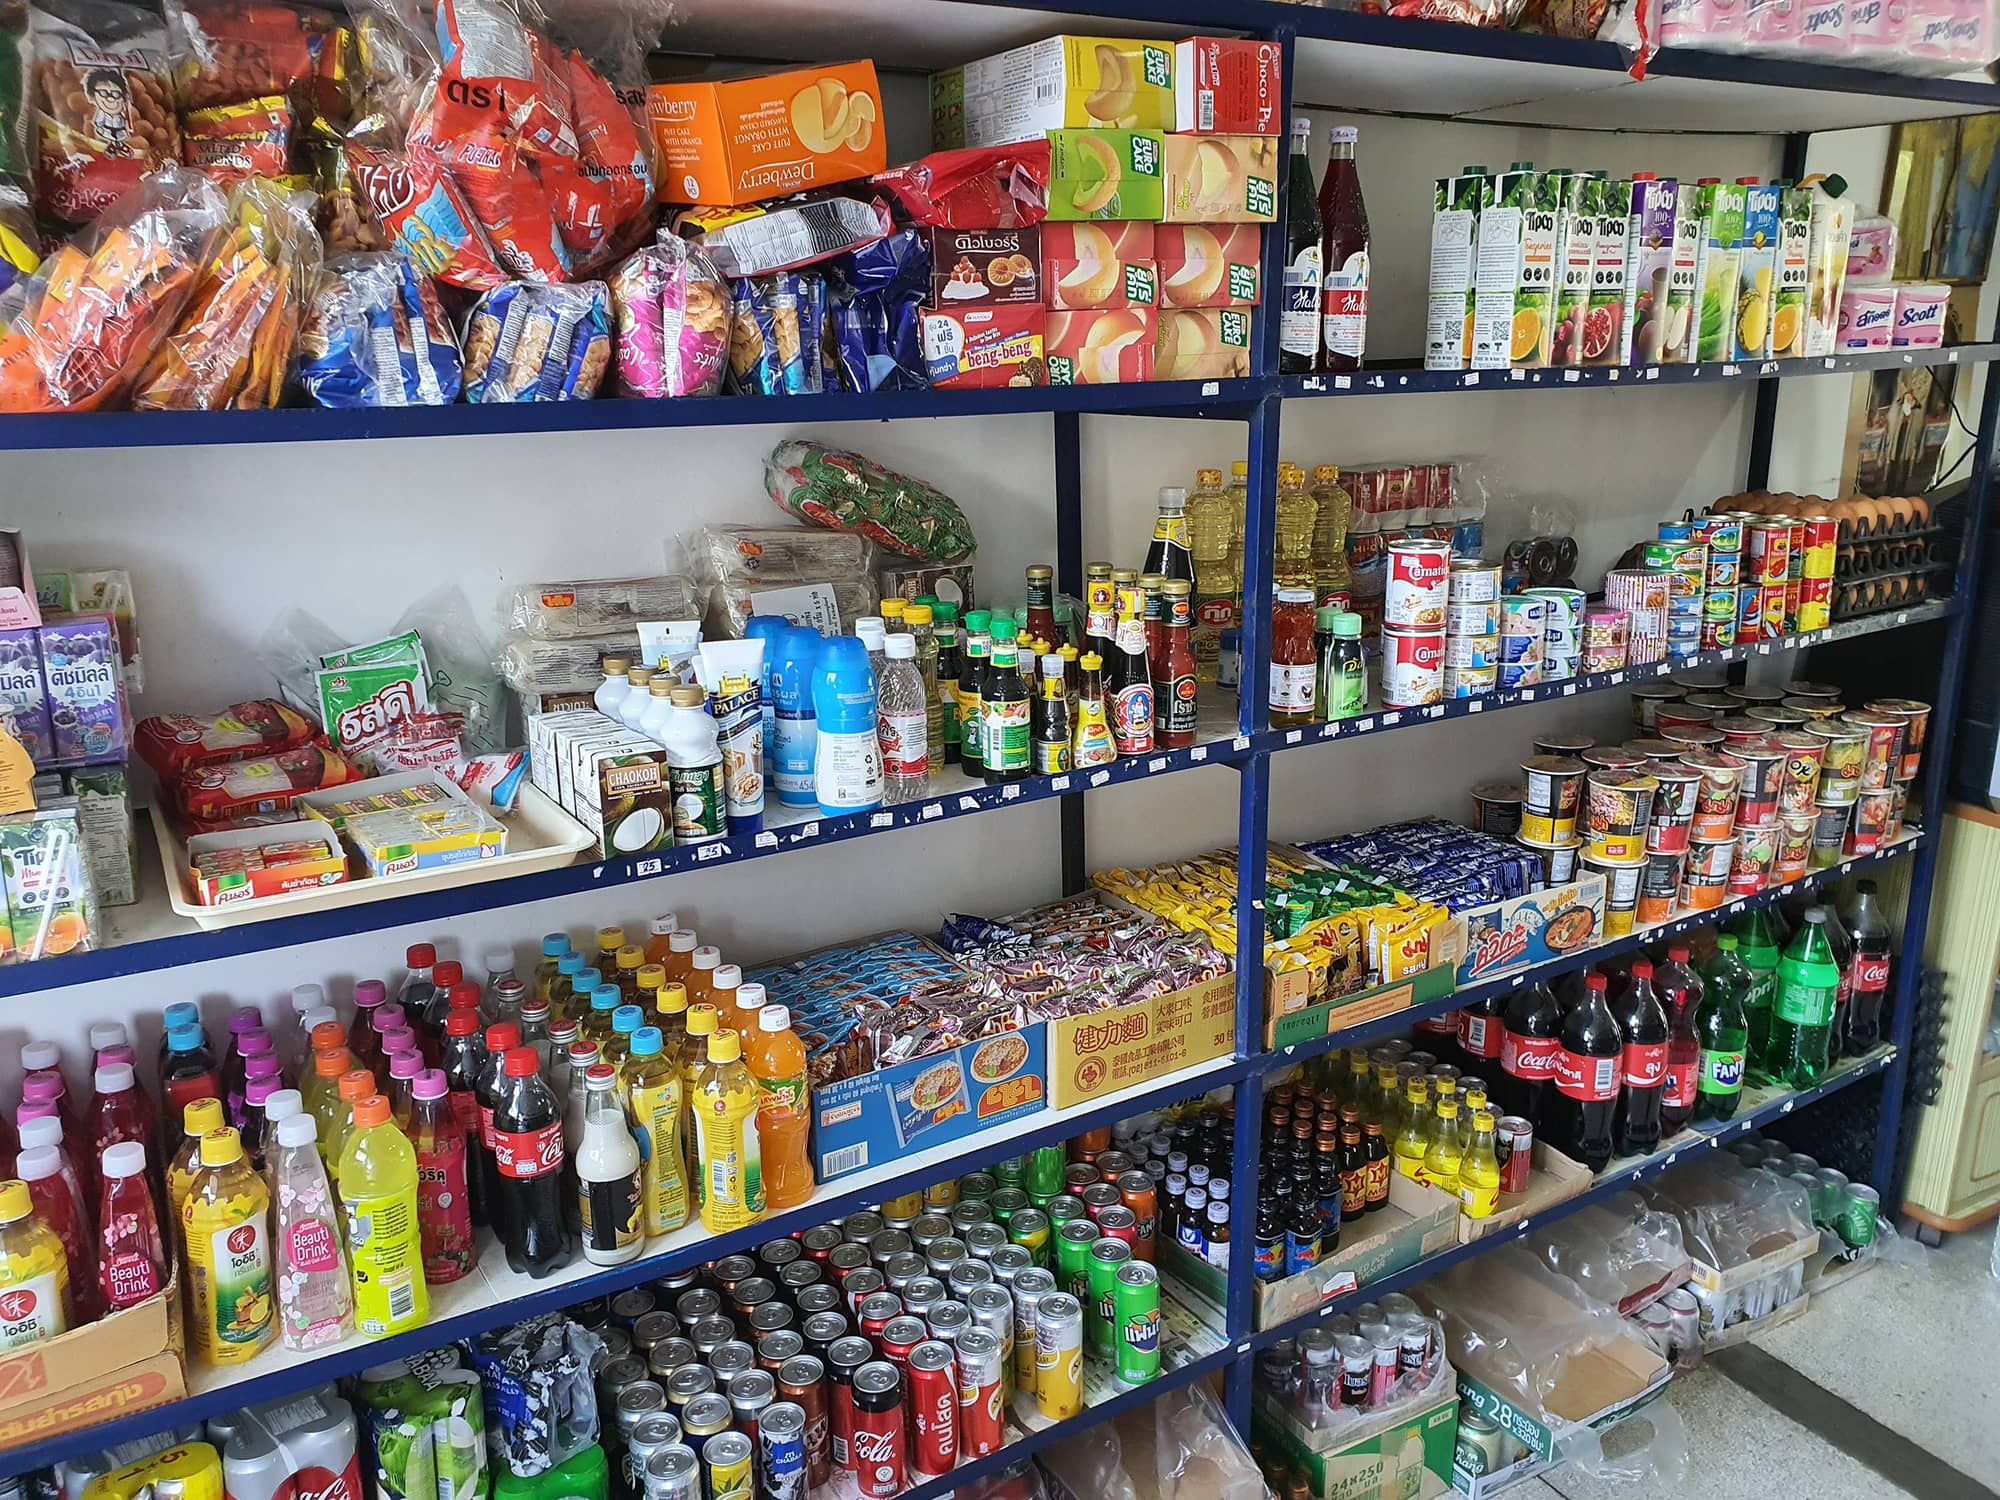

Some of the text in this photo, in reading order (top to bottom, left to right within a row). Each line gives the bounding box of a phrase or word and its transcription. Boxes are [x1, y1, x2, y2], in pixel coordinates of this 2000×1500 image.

[1144, 47, 1158, 85] CAKE
[1152, 48, 1166, 87] EURO
[1257, 44, 1273, 133] Choco-Pie
[649, 94, 698, 119] ewberry
[734, 131, 768, 145] ORANGE
[1132, 136, 1145, 173] CAKE
[1140, 136, 1154, 175] EURO
[737, 161, 815, 191] Dewberry
[1647, 186, 1674, 210] Tipco
[1717, 188, 1744, 213] Tipco
[1749, 189, 1777, 214] Tipco
[1525, 211, 1554, 233] Tipco
[1569, 215, 1593, 237] Tipco
[1596, 217, 1625, 238] Tipco
[1677, 219, 1698, 240] Tipco
[1784, 221, 1807, 240] Tipco
[1898, 303, 1939, 327] Scott
[1222, 311, 1232, 345] CAKE
[1230, 313, 1242, 346] EURO
[967, 341, 1033, 368] beng-beng
[51, 662, 110, 687] ดัชมิลล์
[340, 681, 412, 744] รสดี
[713, 688, 761, 715] PALACE
[608, 767, 659, 787] CHAOKOH
[385, 856, 417, 877] คนอร์
[217, 884, 252, 904] คนอร์
[1072, 1012, 1149, 1056] 健力麵
[1712, 1062, 1744, 1080] FANT
[293, 1227, 330, 1249] Beauti
[297, 1242, 329, 1260] Drink
[109, 1262, 150, 1282] Beauti
[114, 1278, 151, 1296] Drink
[1457, 1382, 1486, 1409] ang
[1488, 1394, 1514, 1429] 28
[855, 1427, 896, 1463] Cola
